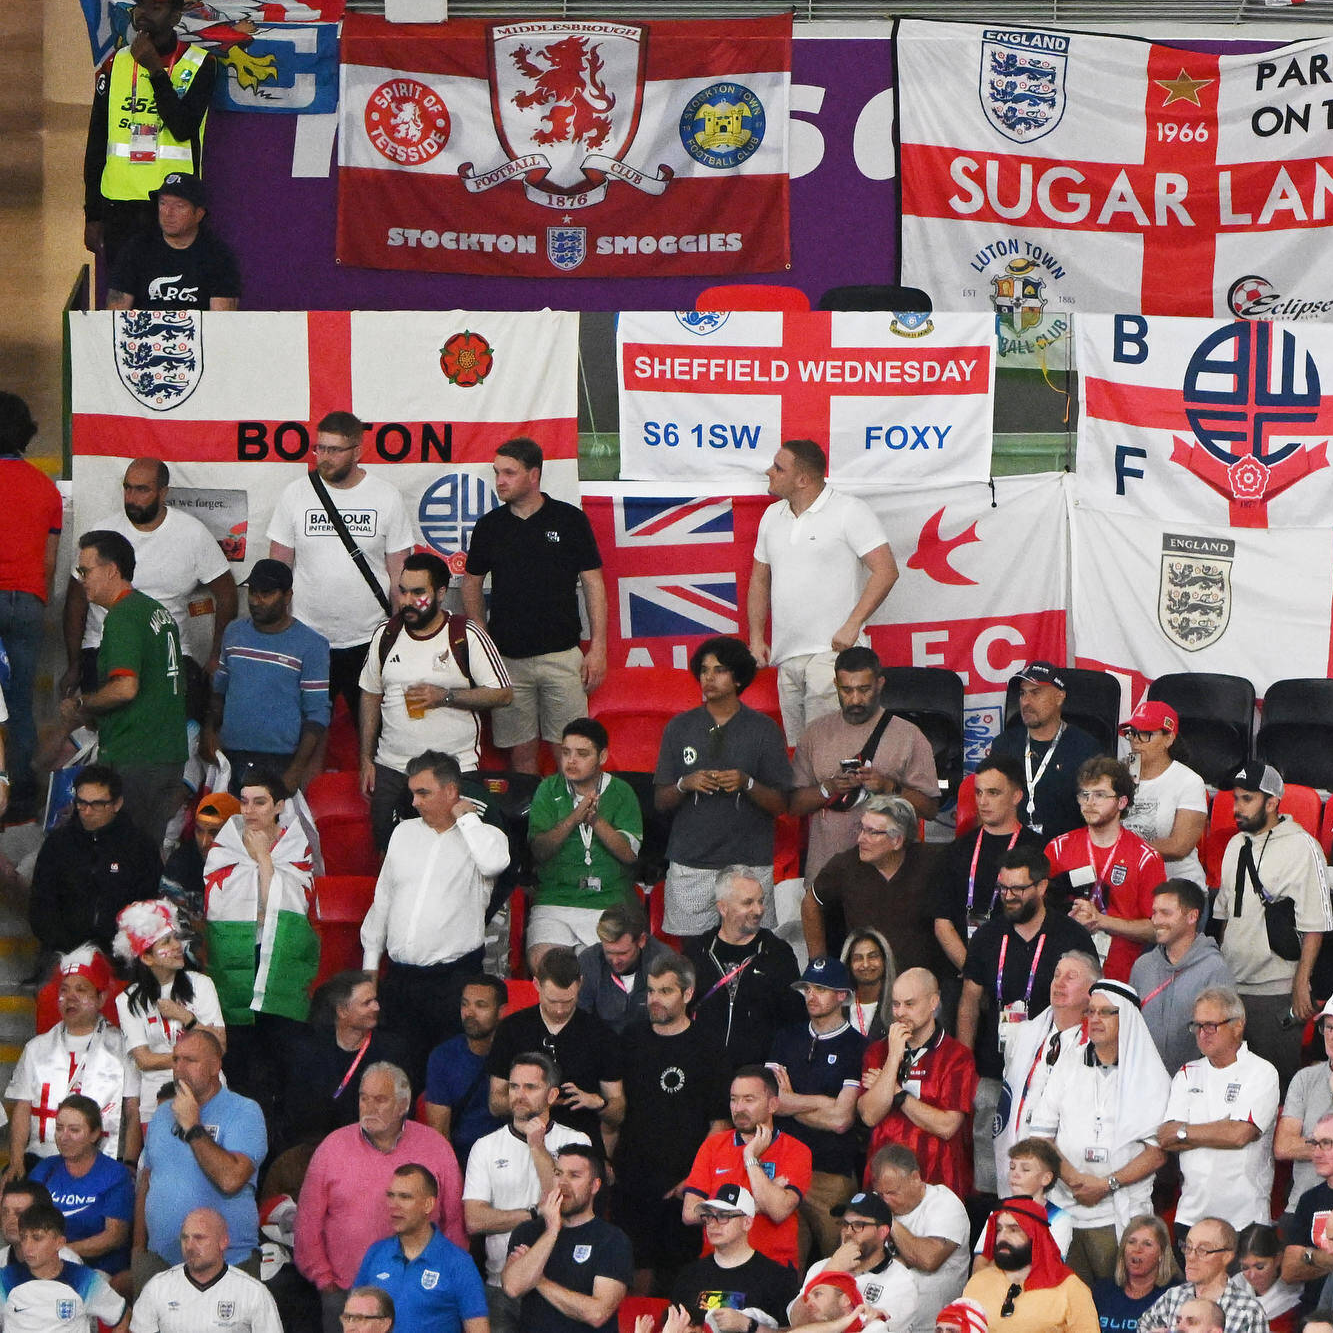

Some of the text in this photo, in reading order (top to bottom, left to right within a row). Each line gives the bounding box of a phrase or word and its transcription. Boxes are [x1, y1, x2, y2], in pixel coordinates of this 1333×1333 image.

[497, 22, 640, 37] MIDDLESBROUGH
[986, 31, 1066, 51] ENGLAND
[124, 97, 157, 113] 352
[374, 83, 443, 113] SPIRIT OF
[684, 85, 762, 120] STOCKTON TOWN
[1156, 122, 1208, 141] 1966
[1251, 103, 1311, 138] ON
[371, 127, 446, 162] TEESSIDE
[686, 137, 760, 166] FOOTBALL CLUB
[472, 155, 537, 190] FOOTBALL
[608, 163, 640, 185] CLUB
[543, 193, 585, 208] 1876
[948, 156, 1196, 228] SUGAR
[387, 228, 743, 255] STOCKTON SMOGGIES
[970, 238, 1066, 280] LUTON TOWN
[1243, 294, 1333, 321] Eclipse
[1113, 314, 1149, 365] B
[634, 357, 977, 384] SHEFFIELD WEDNESDAY
[237, 422, 452, 464] BOON
[643, 421, 952, 450] S6 1SW FOXY
[1115, 444, 1148, 496] F
[179, 499, 193, 507] we
[310, 513, 370, 525] BAOUR
[1170, 538, 1229, 552] ENGLAND
[51, 1191, 96, 1204] LIONS
